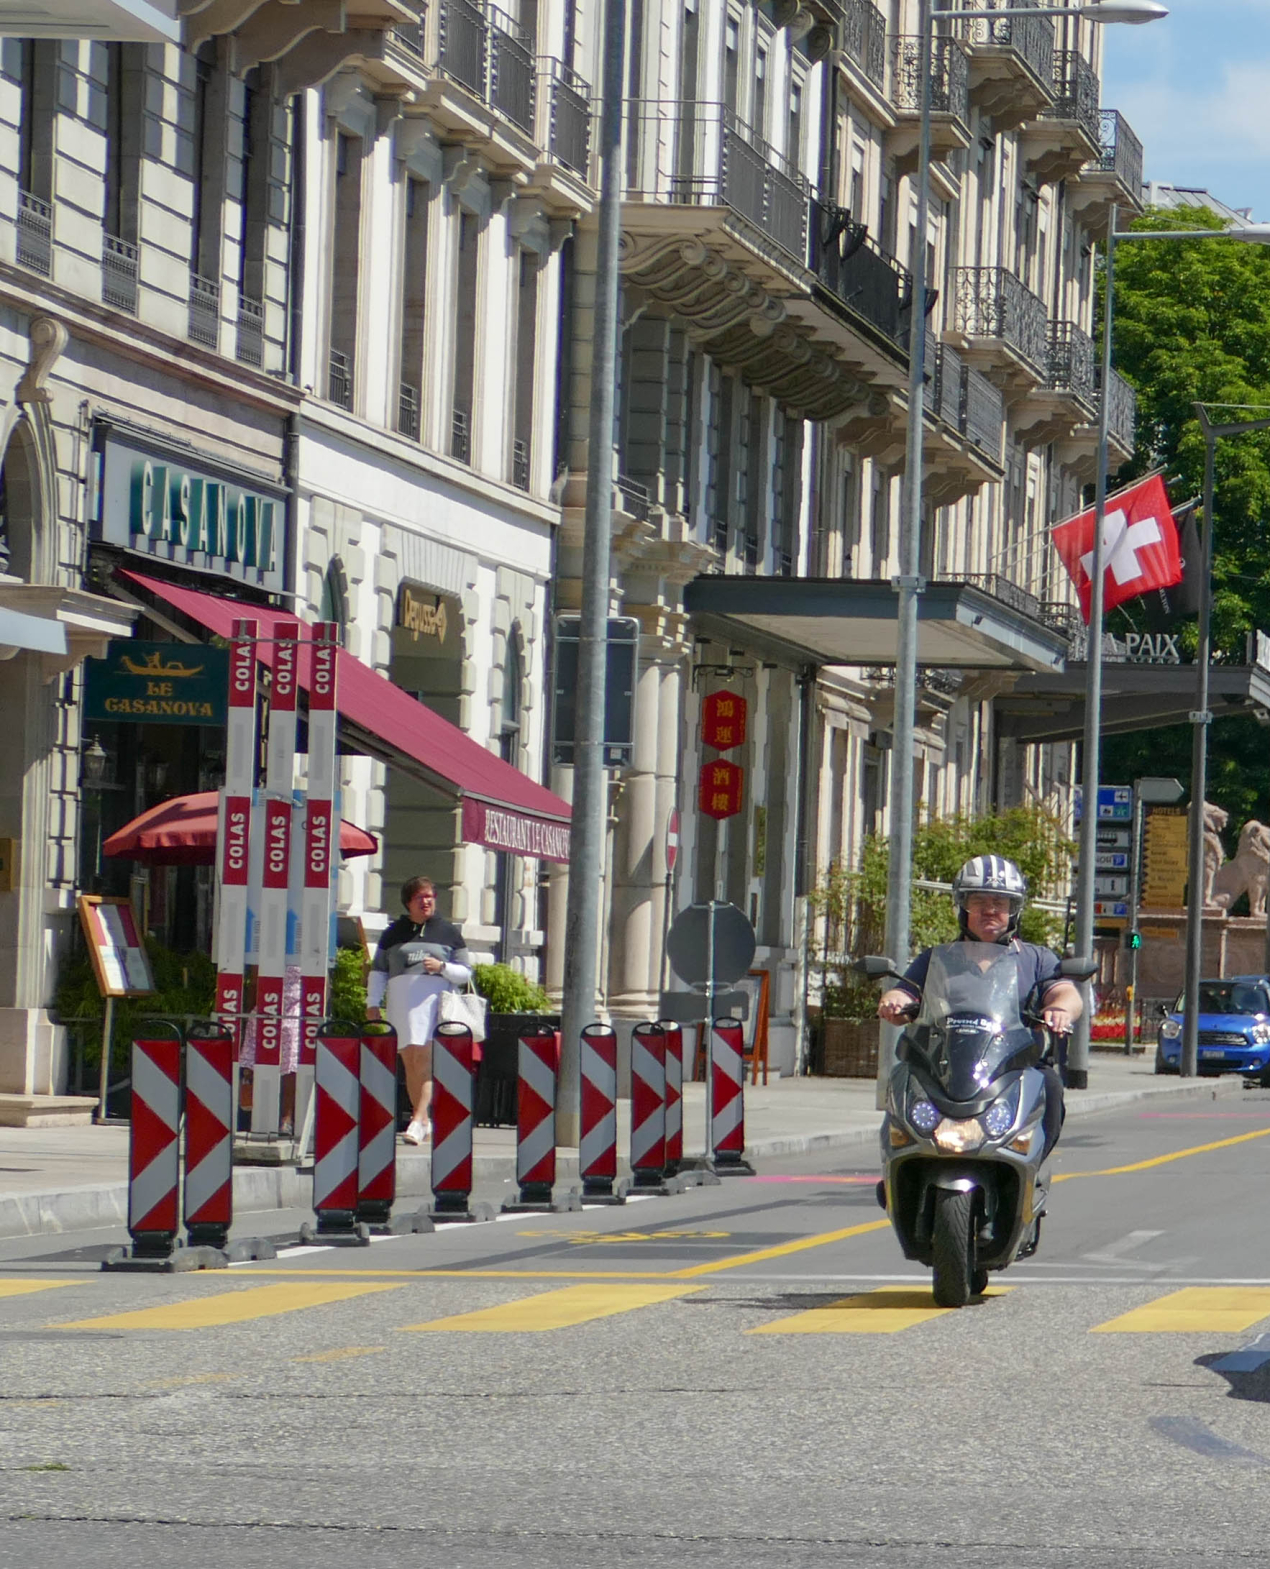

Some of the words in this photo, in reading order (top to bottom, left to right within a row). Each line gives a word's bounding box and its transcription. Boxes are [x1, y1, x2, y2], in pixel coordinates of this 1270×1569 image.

[140, 460, 277, 572] CASANOVA
[1125, 632, 1180, 657] PAIX
[104, 698, 214, 717] CASANOVA
[146, 681, 174, 697] LE
[228, 812, 245, 869] COLAS
[269, 815, 286, 872] COLAS
[310, 815, 326, 872] COLAS
[484, 809, 532, 852] RESTAURANT
[531, 822, 541, 853] LE
[262, 992, 279, 1050] COLAS
